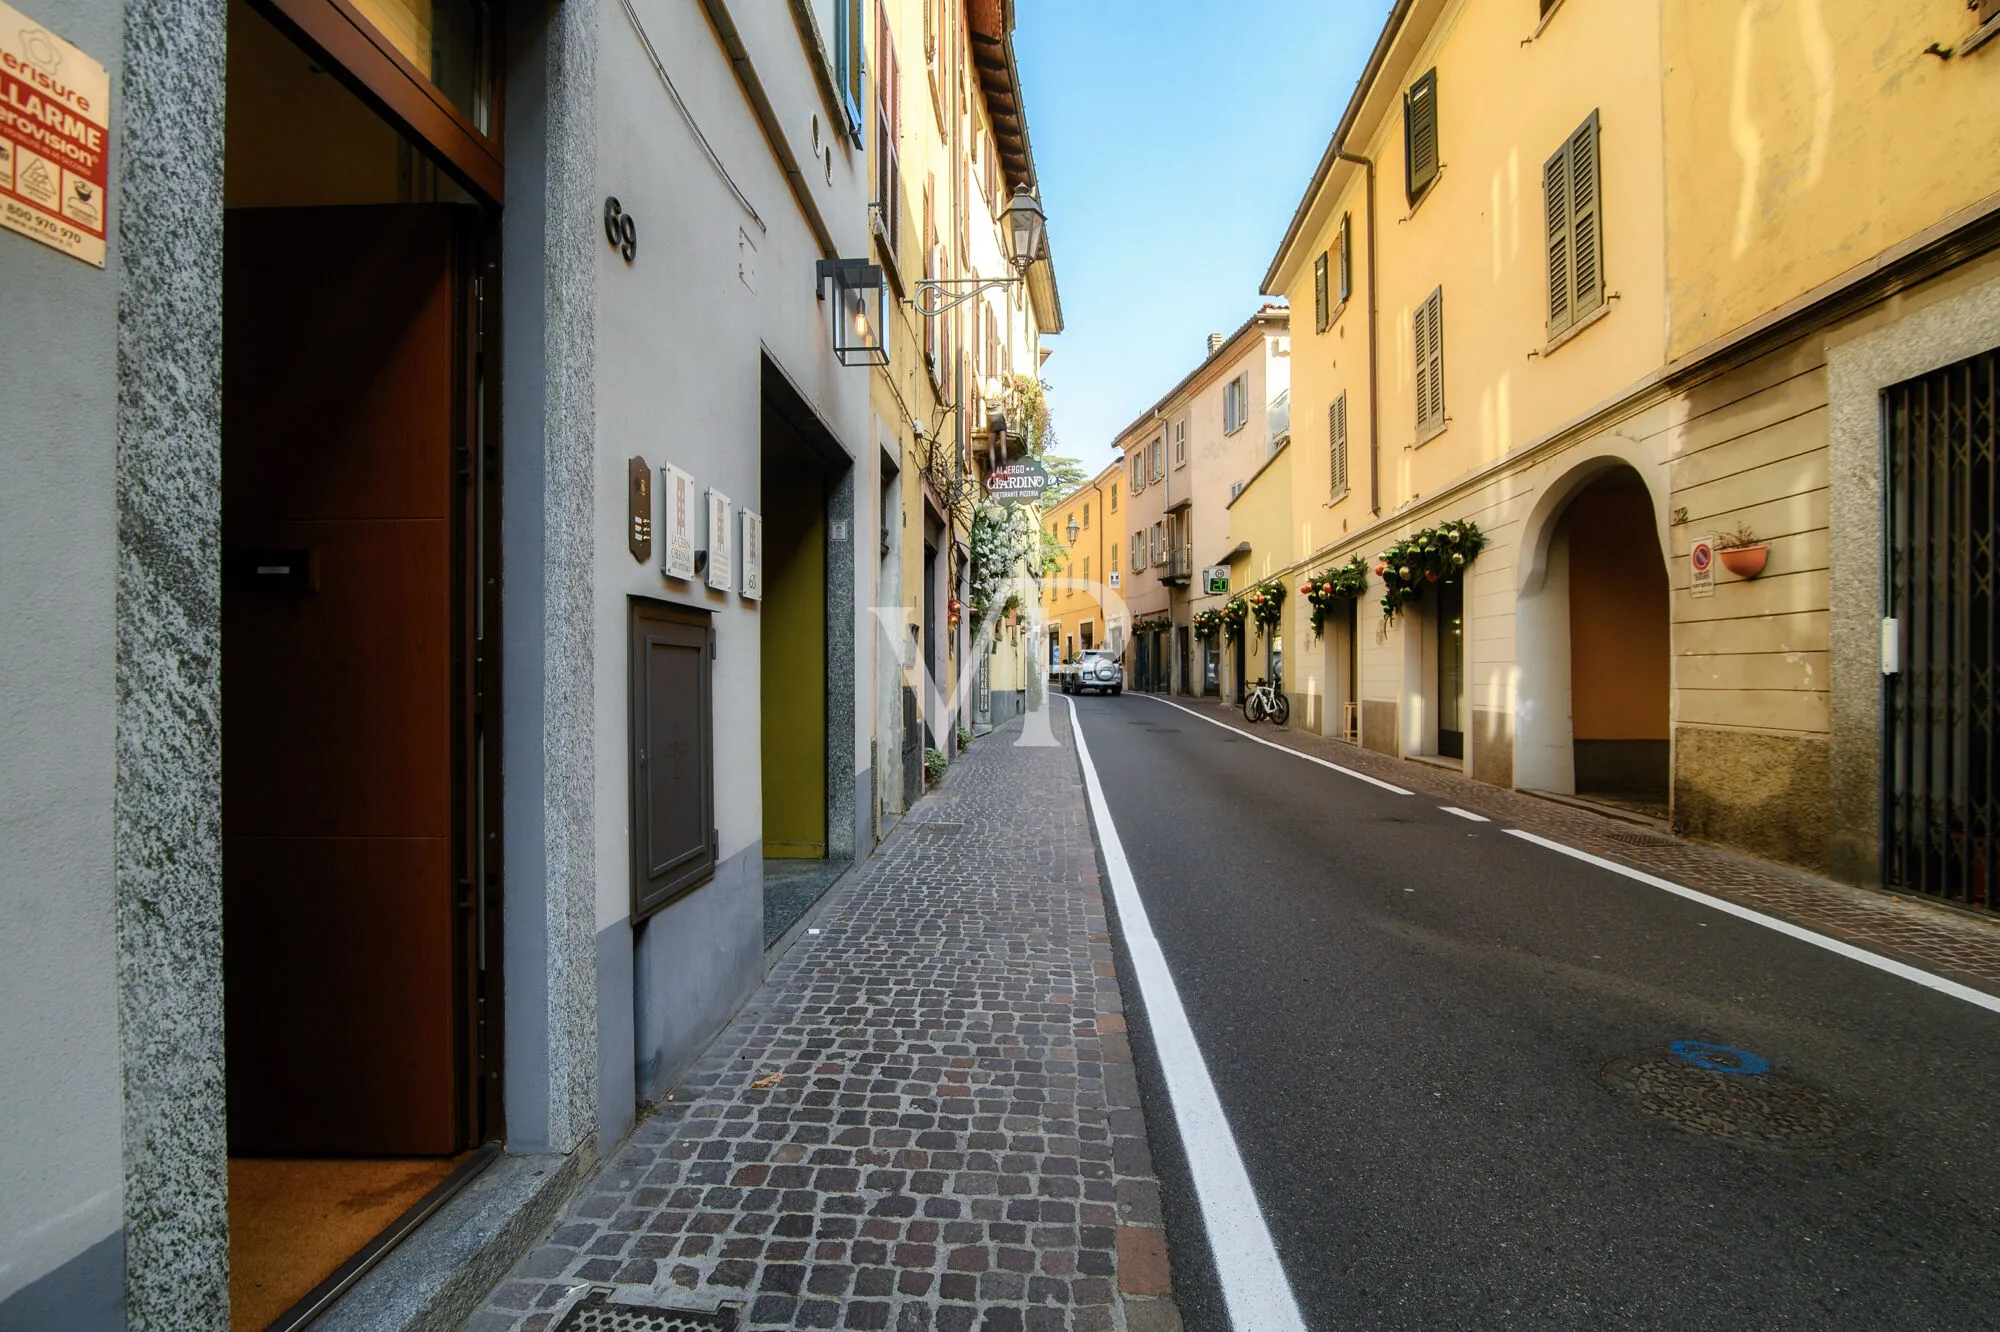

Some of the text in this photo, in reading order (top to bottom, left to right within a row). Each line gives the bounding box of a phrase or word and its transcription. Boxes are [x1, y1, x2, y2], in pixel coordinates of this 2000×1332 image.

[0, 47, 91, 112] erisure
[7, 203, 32, 222] 800
[35, 216, 58, 233] 970
[60, 226, 82, 244] 970
[604, 196, 637, 262] 69
[987, 476, 1045, 490] GIARDINO
[1213, 579, 1228, 592] 20
